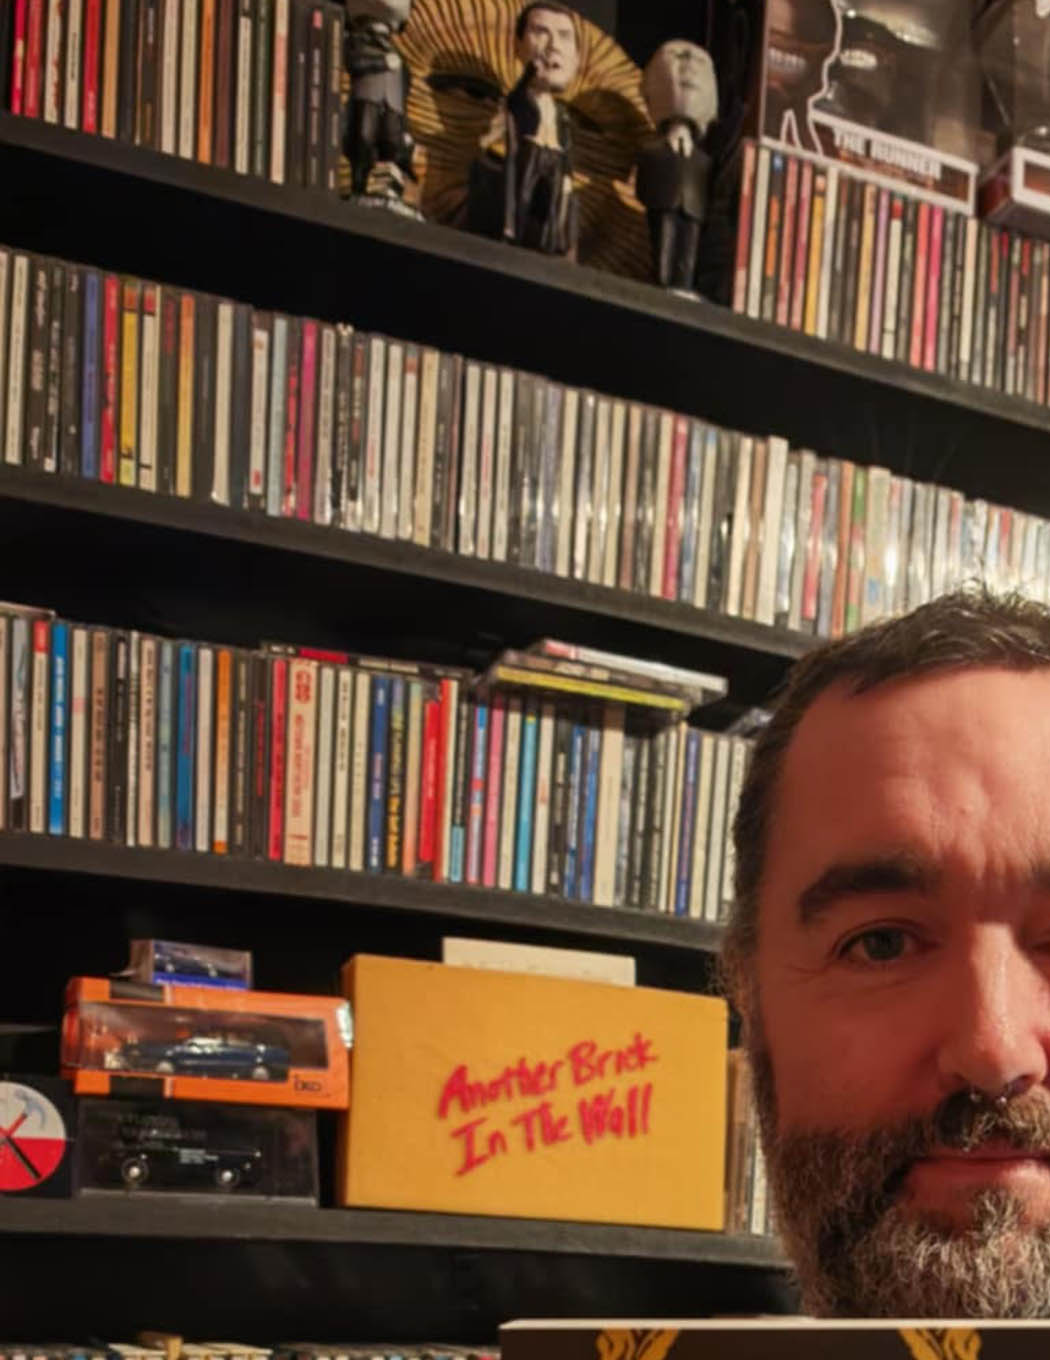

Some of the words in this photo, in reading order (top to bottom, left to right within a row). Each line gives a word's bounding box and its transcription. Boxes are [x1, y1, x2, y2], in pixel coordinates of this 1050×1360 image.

[833, 127, 865, 155] THE
[437, 1058, 563, 1120] Another
[567, 1032, 661, 1087] Brick
[450, 1117, 507, 1178] In
[511, 1102, 573, 1153] The
[579, 1083, 654, 1146] Wall
